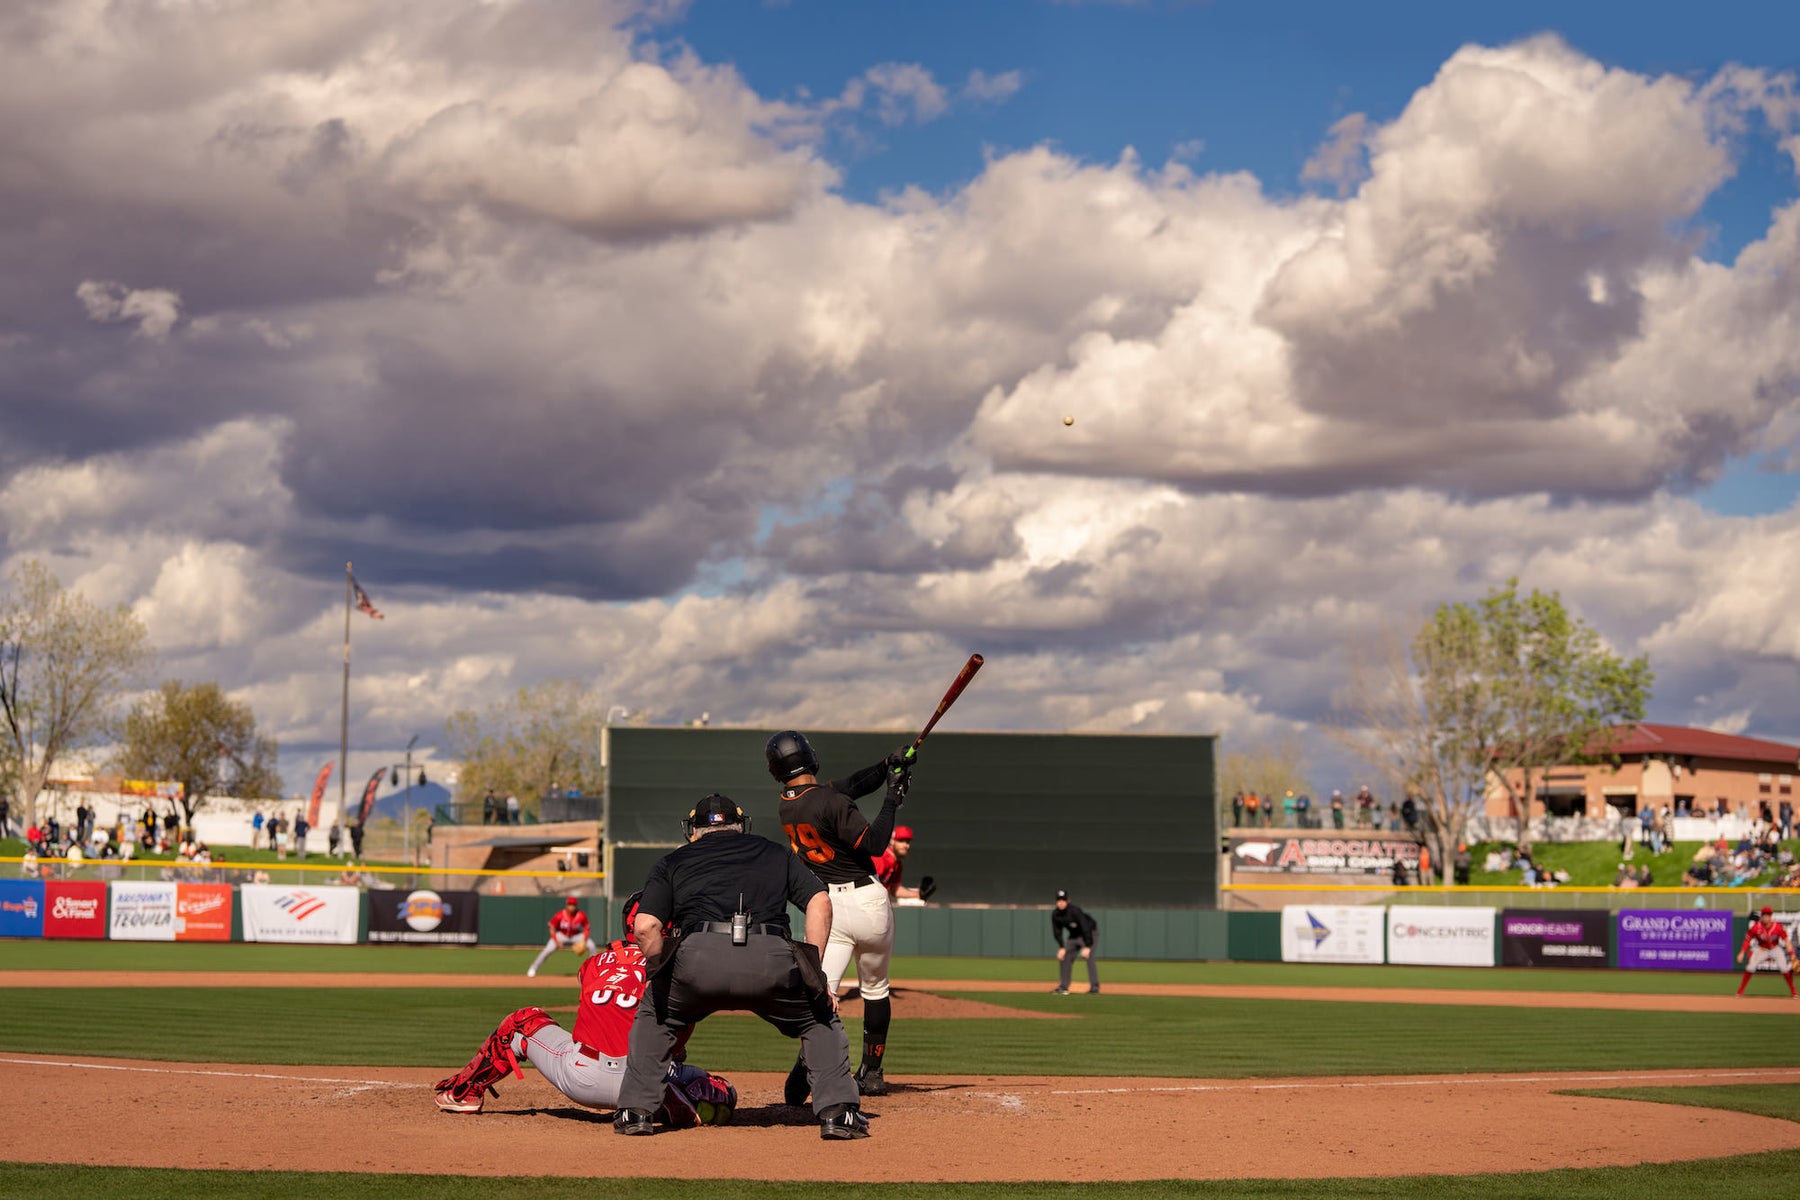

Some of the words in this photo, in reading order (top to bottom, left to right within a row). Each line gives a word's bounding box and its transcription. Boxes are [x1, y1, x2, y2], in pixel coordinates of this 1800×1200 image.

[1307, 856, 1345, 869] SIGN
[66, 897, 97, 910] Smart
[69, 909, 95, 919] Final
[114, 912, 170, 928] TEQUILA
[1507, 923, 1581, 936] HONORHEALTH
[1622, 915, 1670, 932] GRAND
[1670, 915, 1727, 933] CANYON
[1394, 923, 1490, 939] CONCENTRIC
[1640, 930, 1706, 941] UNIVERSITY
[844, 1111, 853, 1125] N
